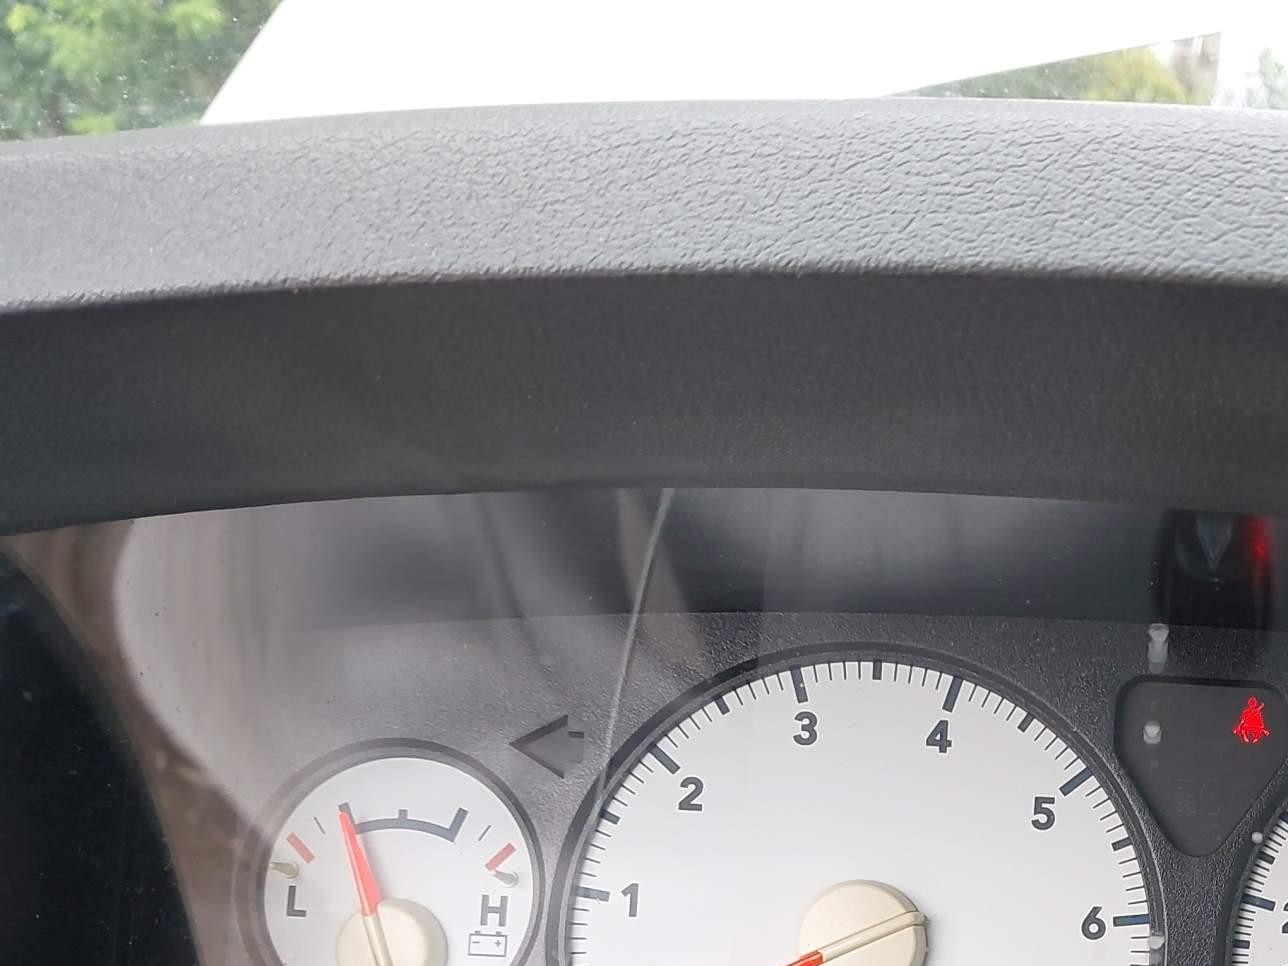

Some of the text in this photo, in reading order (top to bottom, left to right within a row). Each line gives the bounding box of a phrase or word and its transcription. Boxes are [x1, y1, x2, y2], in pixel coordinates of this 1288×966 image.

[793, 711, 817, 745] 3
[926, 720, 952, 753] 4
[678, 777, 704, 811] 2
[1031, 797, 1055, 830] 5
[286, 885, 307, 917] L
[480, 895, 508, 927] H
[621, 883, 639, 917] 1
[1081, 906, 1106, 940] 6
